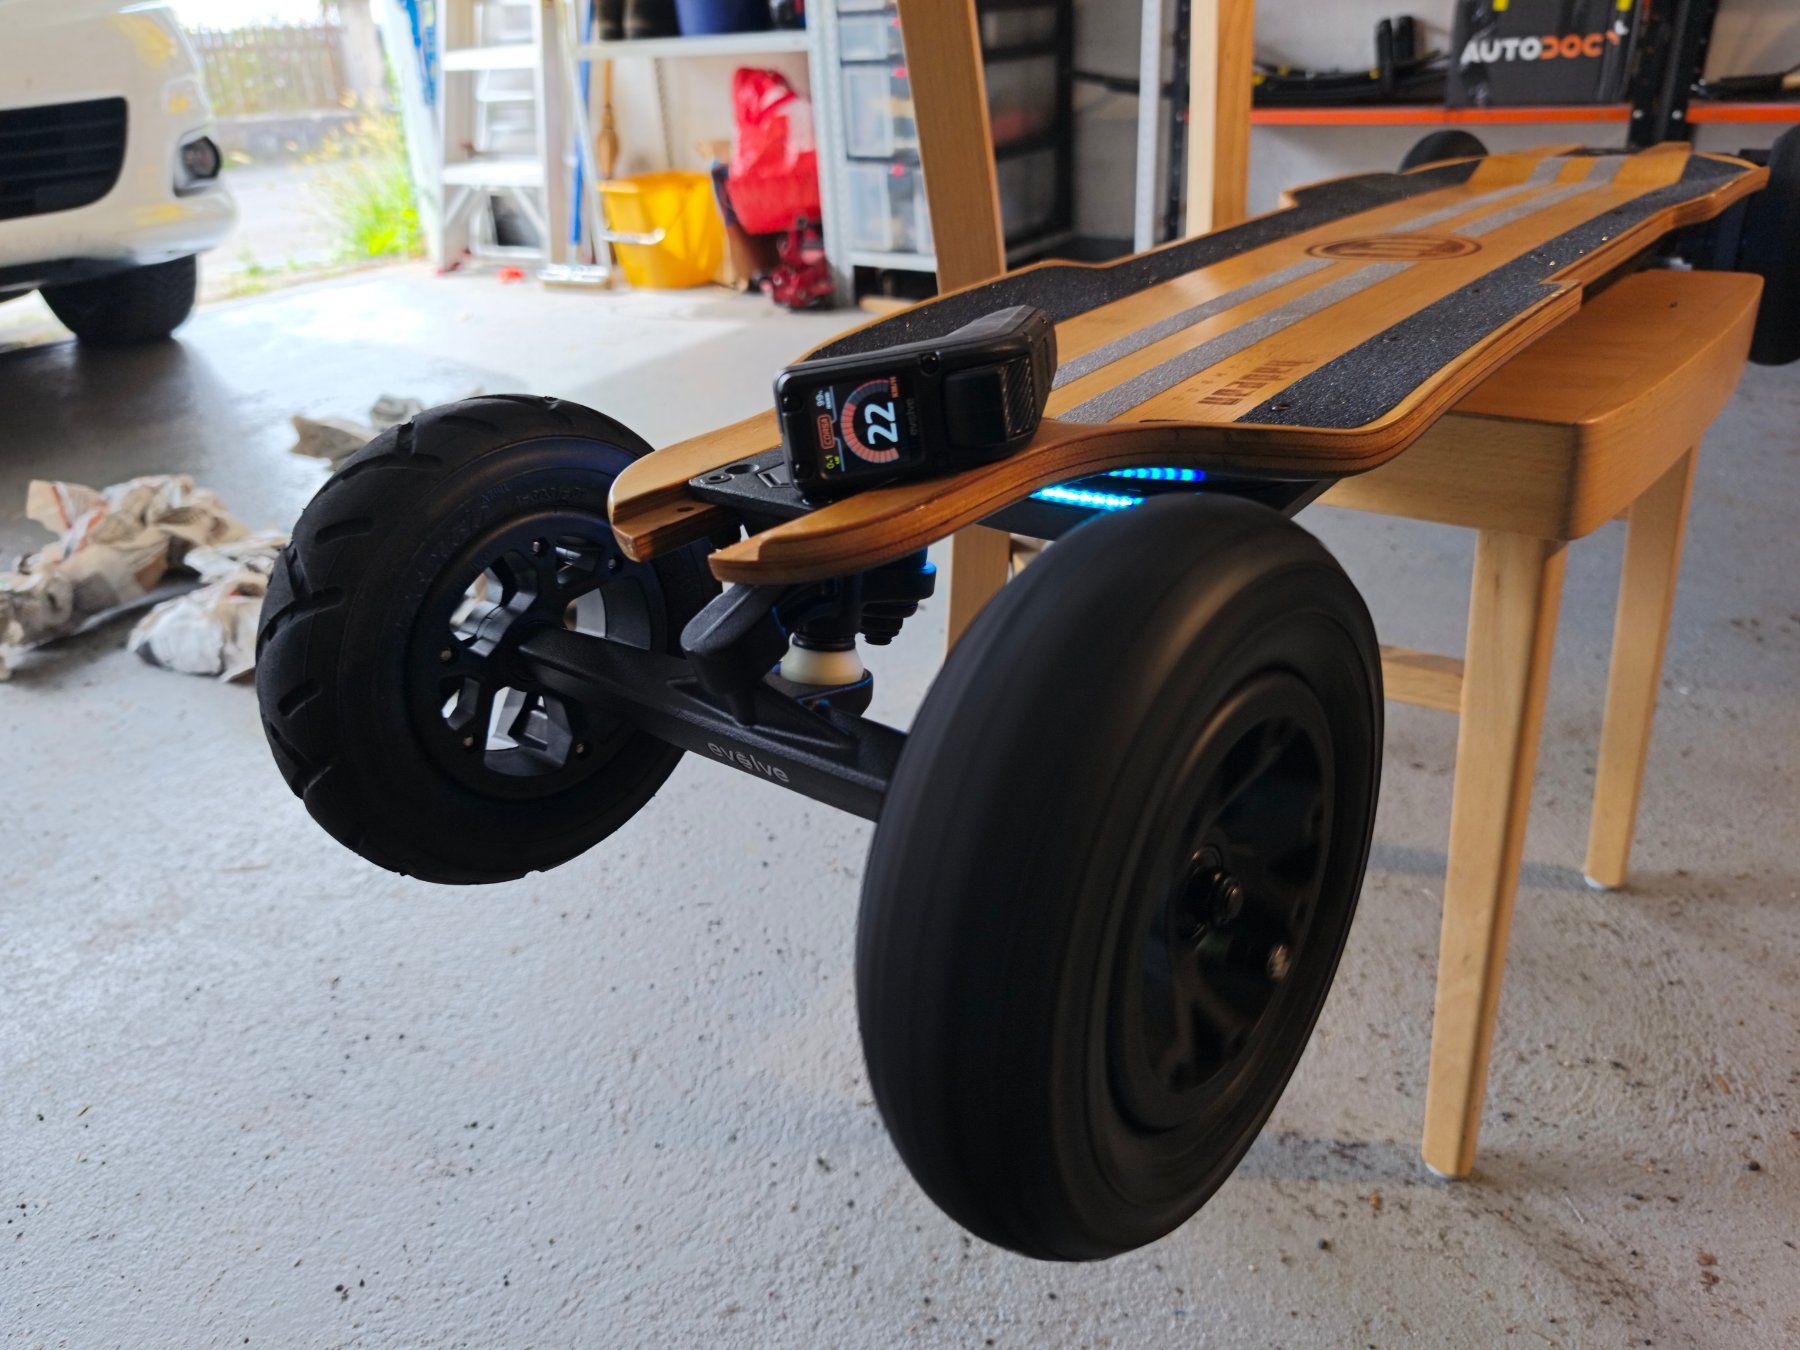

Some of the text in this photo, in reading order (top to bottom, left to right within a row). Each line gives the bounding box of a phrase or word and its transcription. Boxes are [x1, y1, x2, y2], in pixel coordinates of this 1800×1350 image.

[1460, 32, 1604, 66] AUTODOC
[864, 401, 899, 445] 22
[707, 742, 790, 783] evolve
